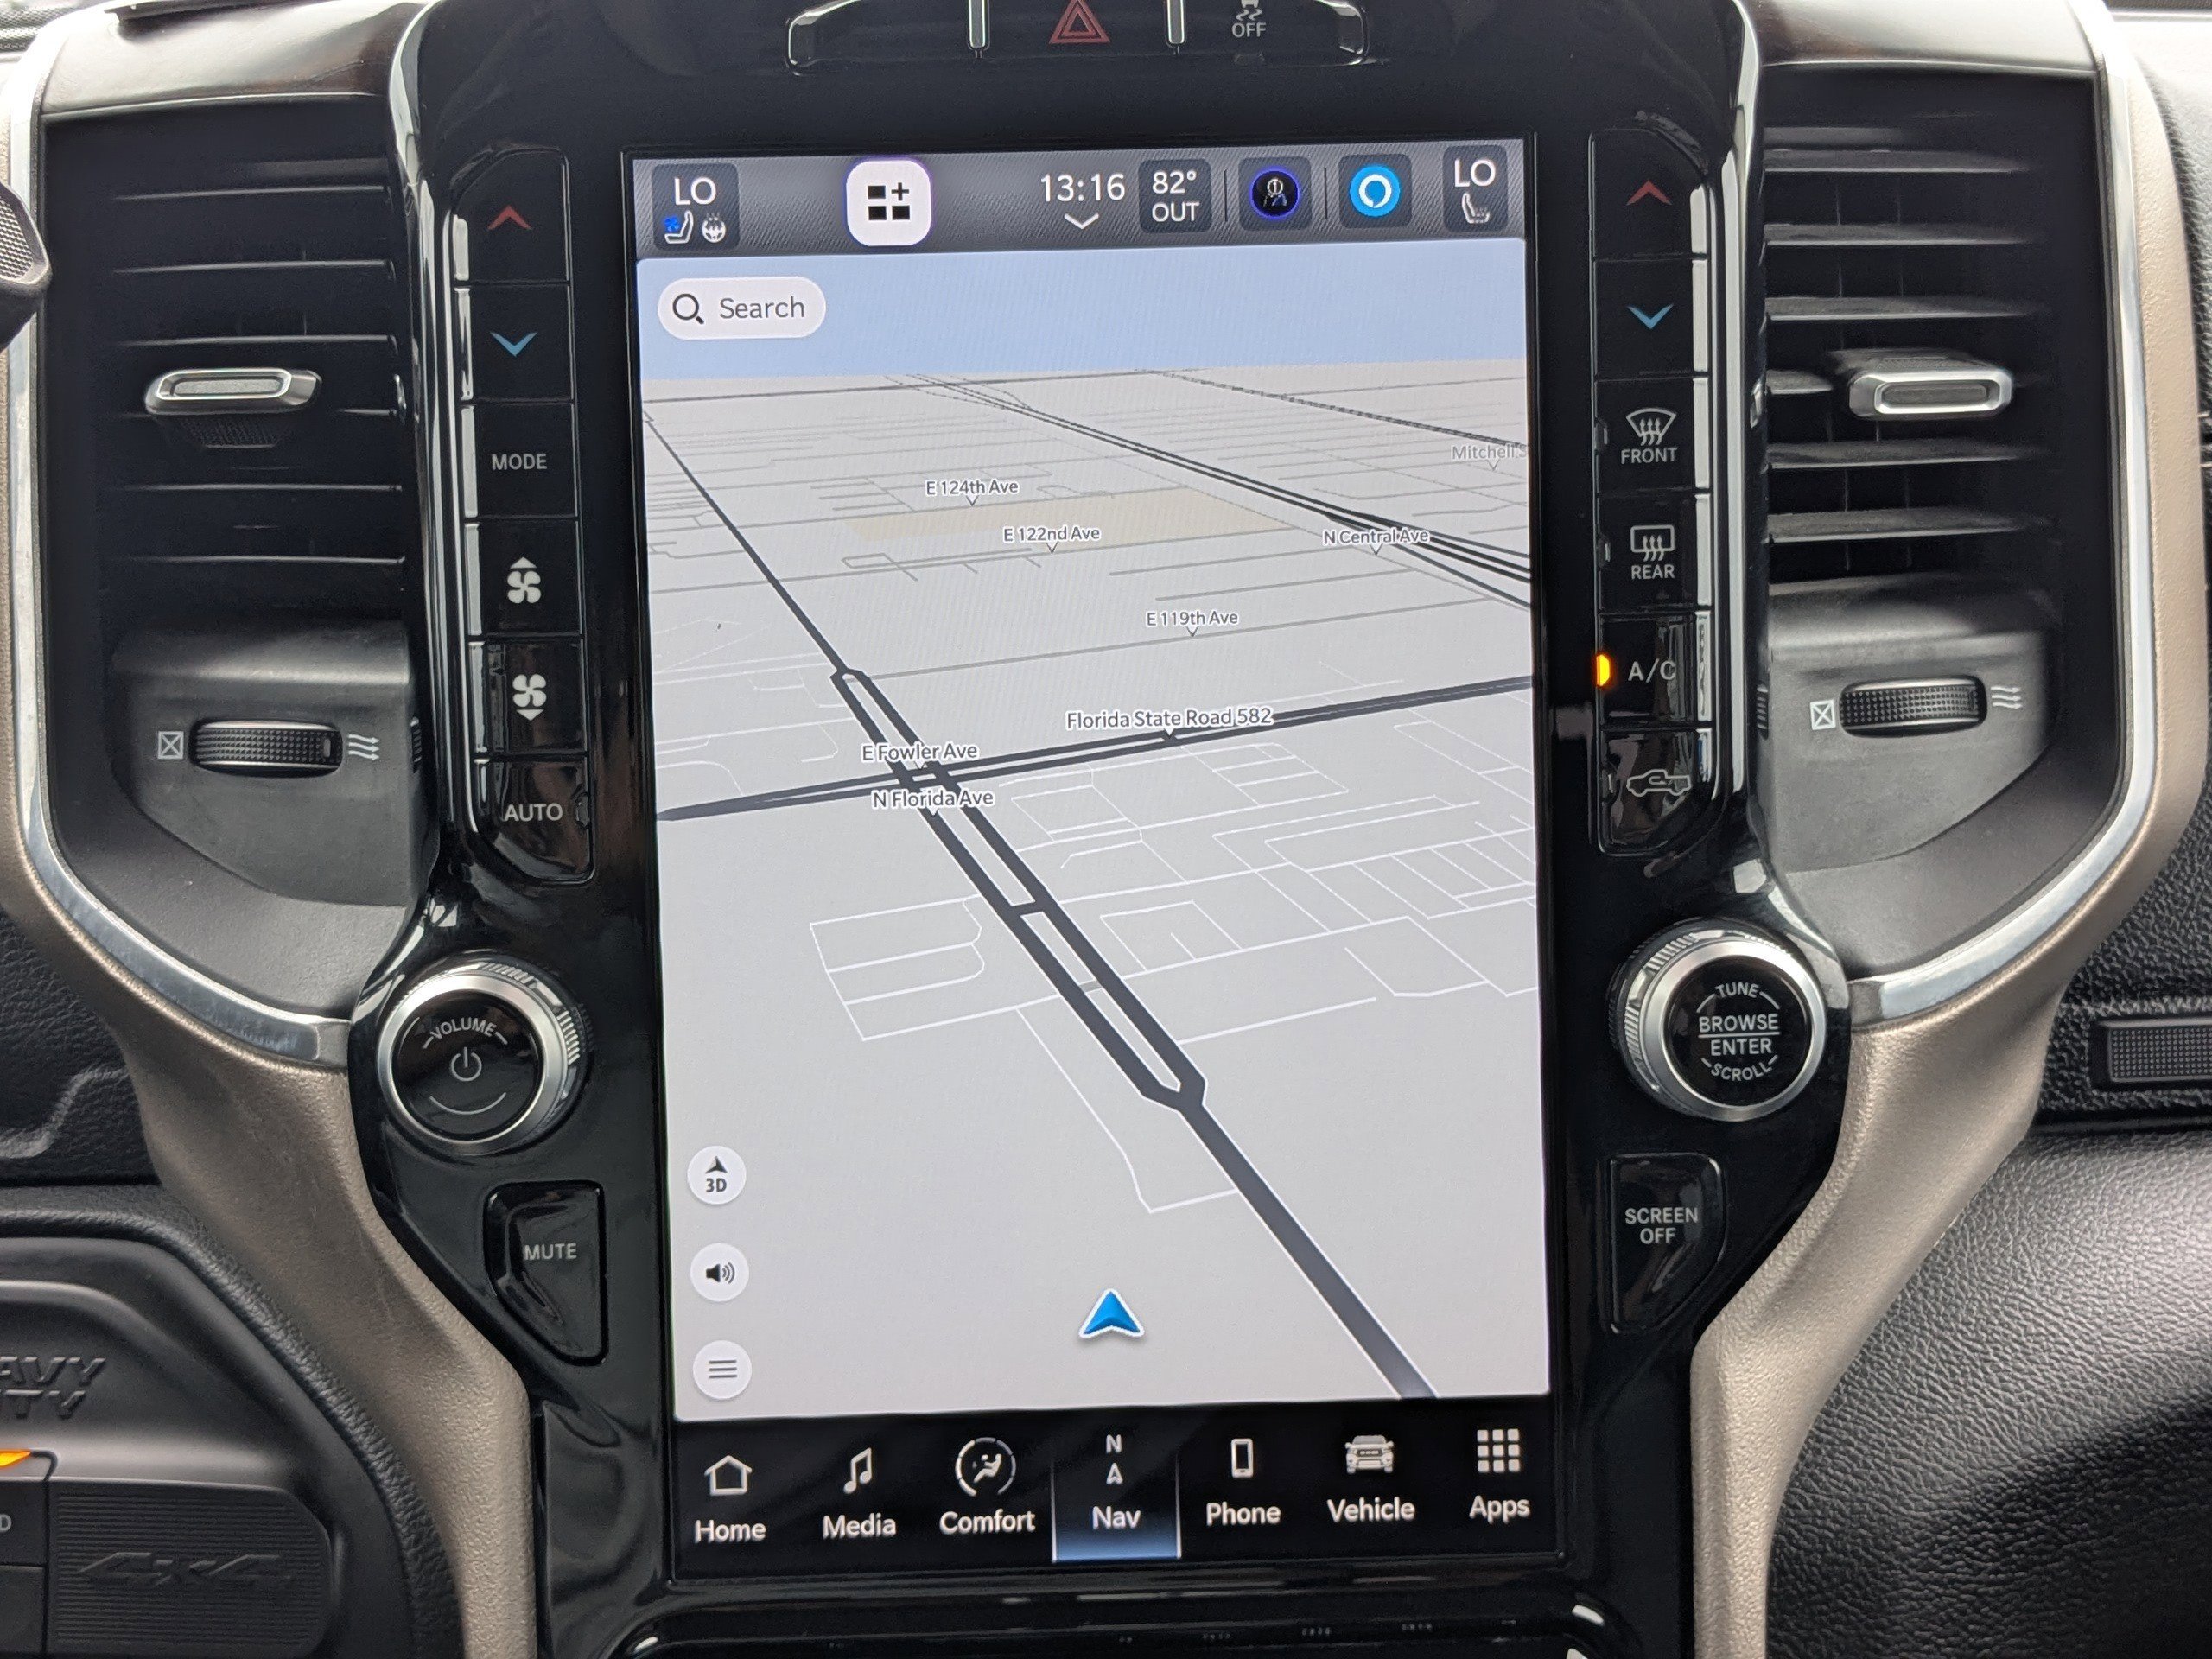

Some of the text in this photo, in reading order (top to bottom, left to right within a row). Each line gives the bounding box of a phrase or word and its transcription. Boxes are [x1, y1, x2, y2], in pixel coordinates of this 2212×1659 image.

[1231, 22, 1267, 38] OFF
[1152, 170, 1198, 194] 82°
[1454, 158, 1496, 187] LO
[674, 177, 716, 206] LO
[1040, 173, 1126, 202] 13:16
[1152, 201, 1200, 222] OUT
[719, 296, 805, 320] Search
[492, 453, 548, 471] MODE
[1452, 444, 1515, 460] Mitchell
[1621, 447, 1678, 465] FRONT
[926, 480, 1019, 495] E 124th Ave
[1004, 526, 1101, 542] E 122nd Ave
[1324, 528, 1428, 544] N Central Ave
[1630, 563, 1675, 580] REAR
[1147, 610, 1238, 626] E 119th Ave
[1627, 658, 1676, 683] A/C
[1067, 707, 1273, 728] Florida State Road 582
[862, 743, 978, 760] E Fowler Ave
[874, 790, 994, 808] N Florida Ave
[504, 802, 563, 823] AUTO
[1714, 982, 1760, 999] TUNE
[429, 1016, 498, 1039] VOLUME
[1699, 1013, 1779, 1033] BROWSE
[1710, 1038, 1772, 1057] ENTER
[1710, 1061, 1772, 1082] SCROLL
[705, 1177, 728, 1193] 3D
[1624, 1206, 1699, 1225] SCREEN
[1639, 1227, 1676, 1245] OFF
[523, 1243, 577, 1261] MUTE
[1106, 1433, 1122, 1454] N
[1091, 1505, 1141, 1530] Nav
[1205, 1501, 1281, 1526] Phone
[1326, 1496, 1416, 1522] Vehicle
[1469, 1494, 1531, 1524] Apps
[694, 1519, 767, 1544] Home
[823, 1512, 897, 1539] Media
[939, 1508, 1037, 1535] Comfort
